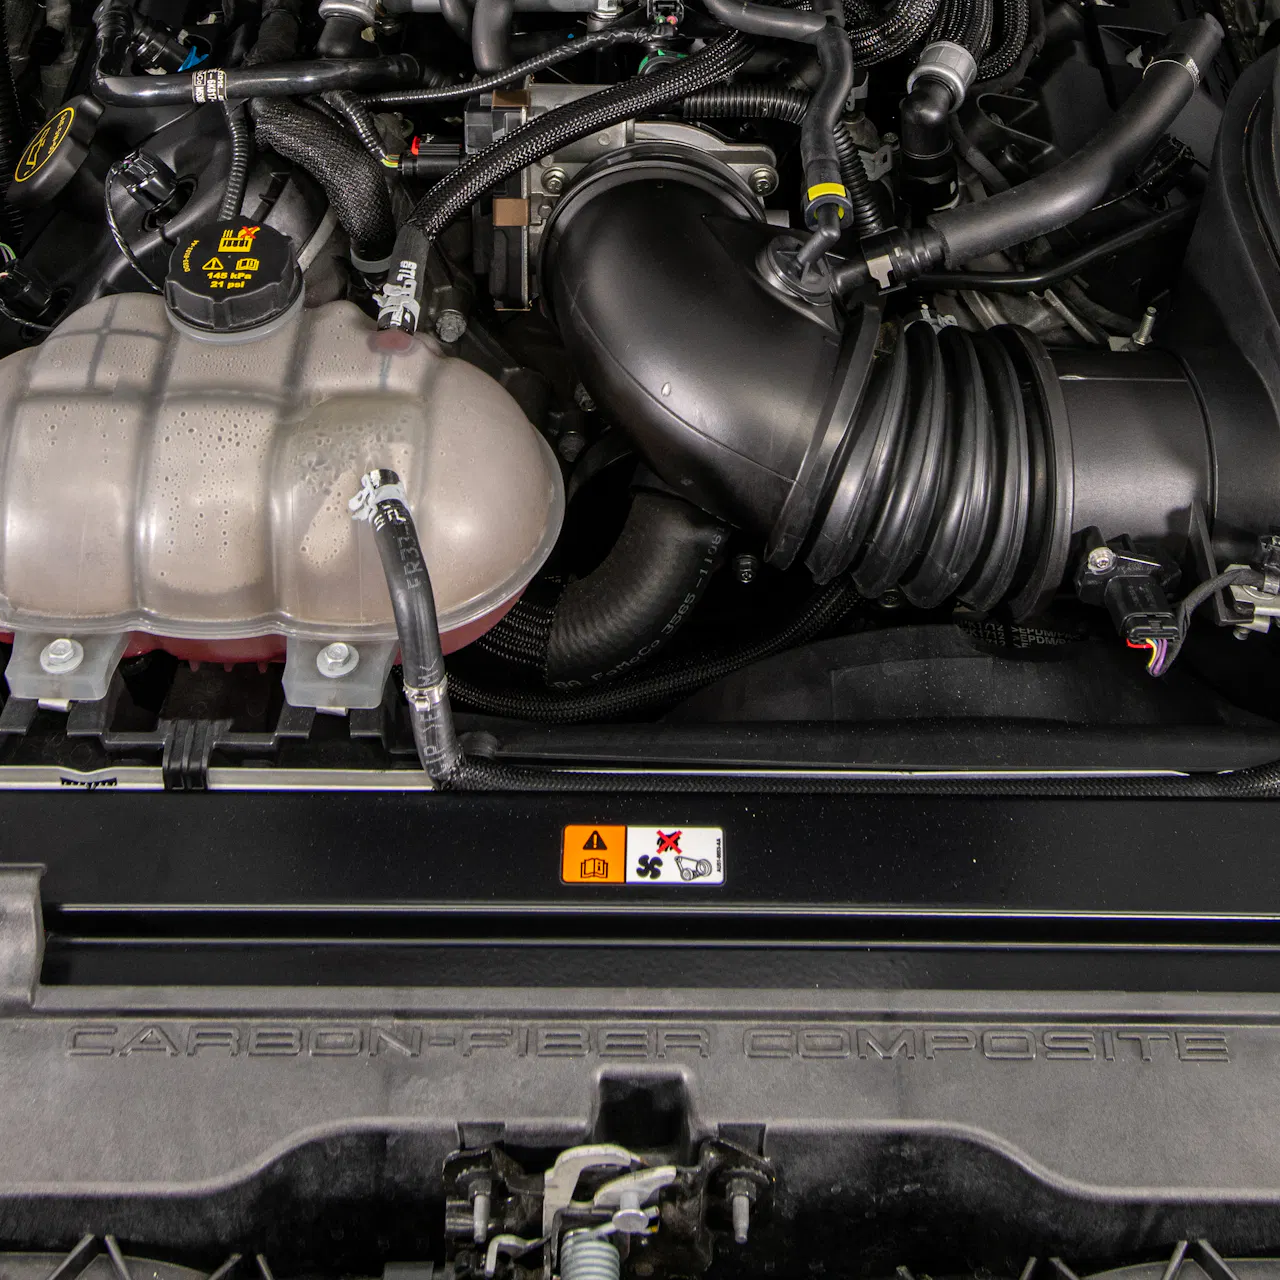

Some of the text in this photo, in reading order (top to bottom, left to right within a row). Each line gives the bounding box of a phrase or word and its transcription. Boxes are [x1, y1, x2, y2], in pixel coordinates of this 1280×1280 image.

[206, 271, 252, 280] 145 kPa
[209, 280, 245, 289] 21 psi
[591, 639, 661, 681] FoMoCo
[65, 1025, 1234, 1059] CARBON-FIBER COMPOSITE
